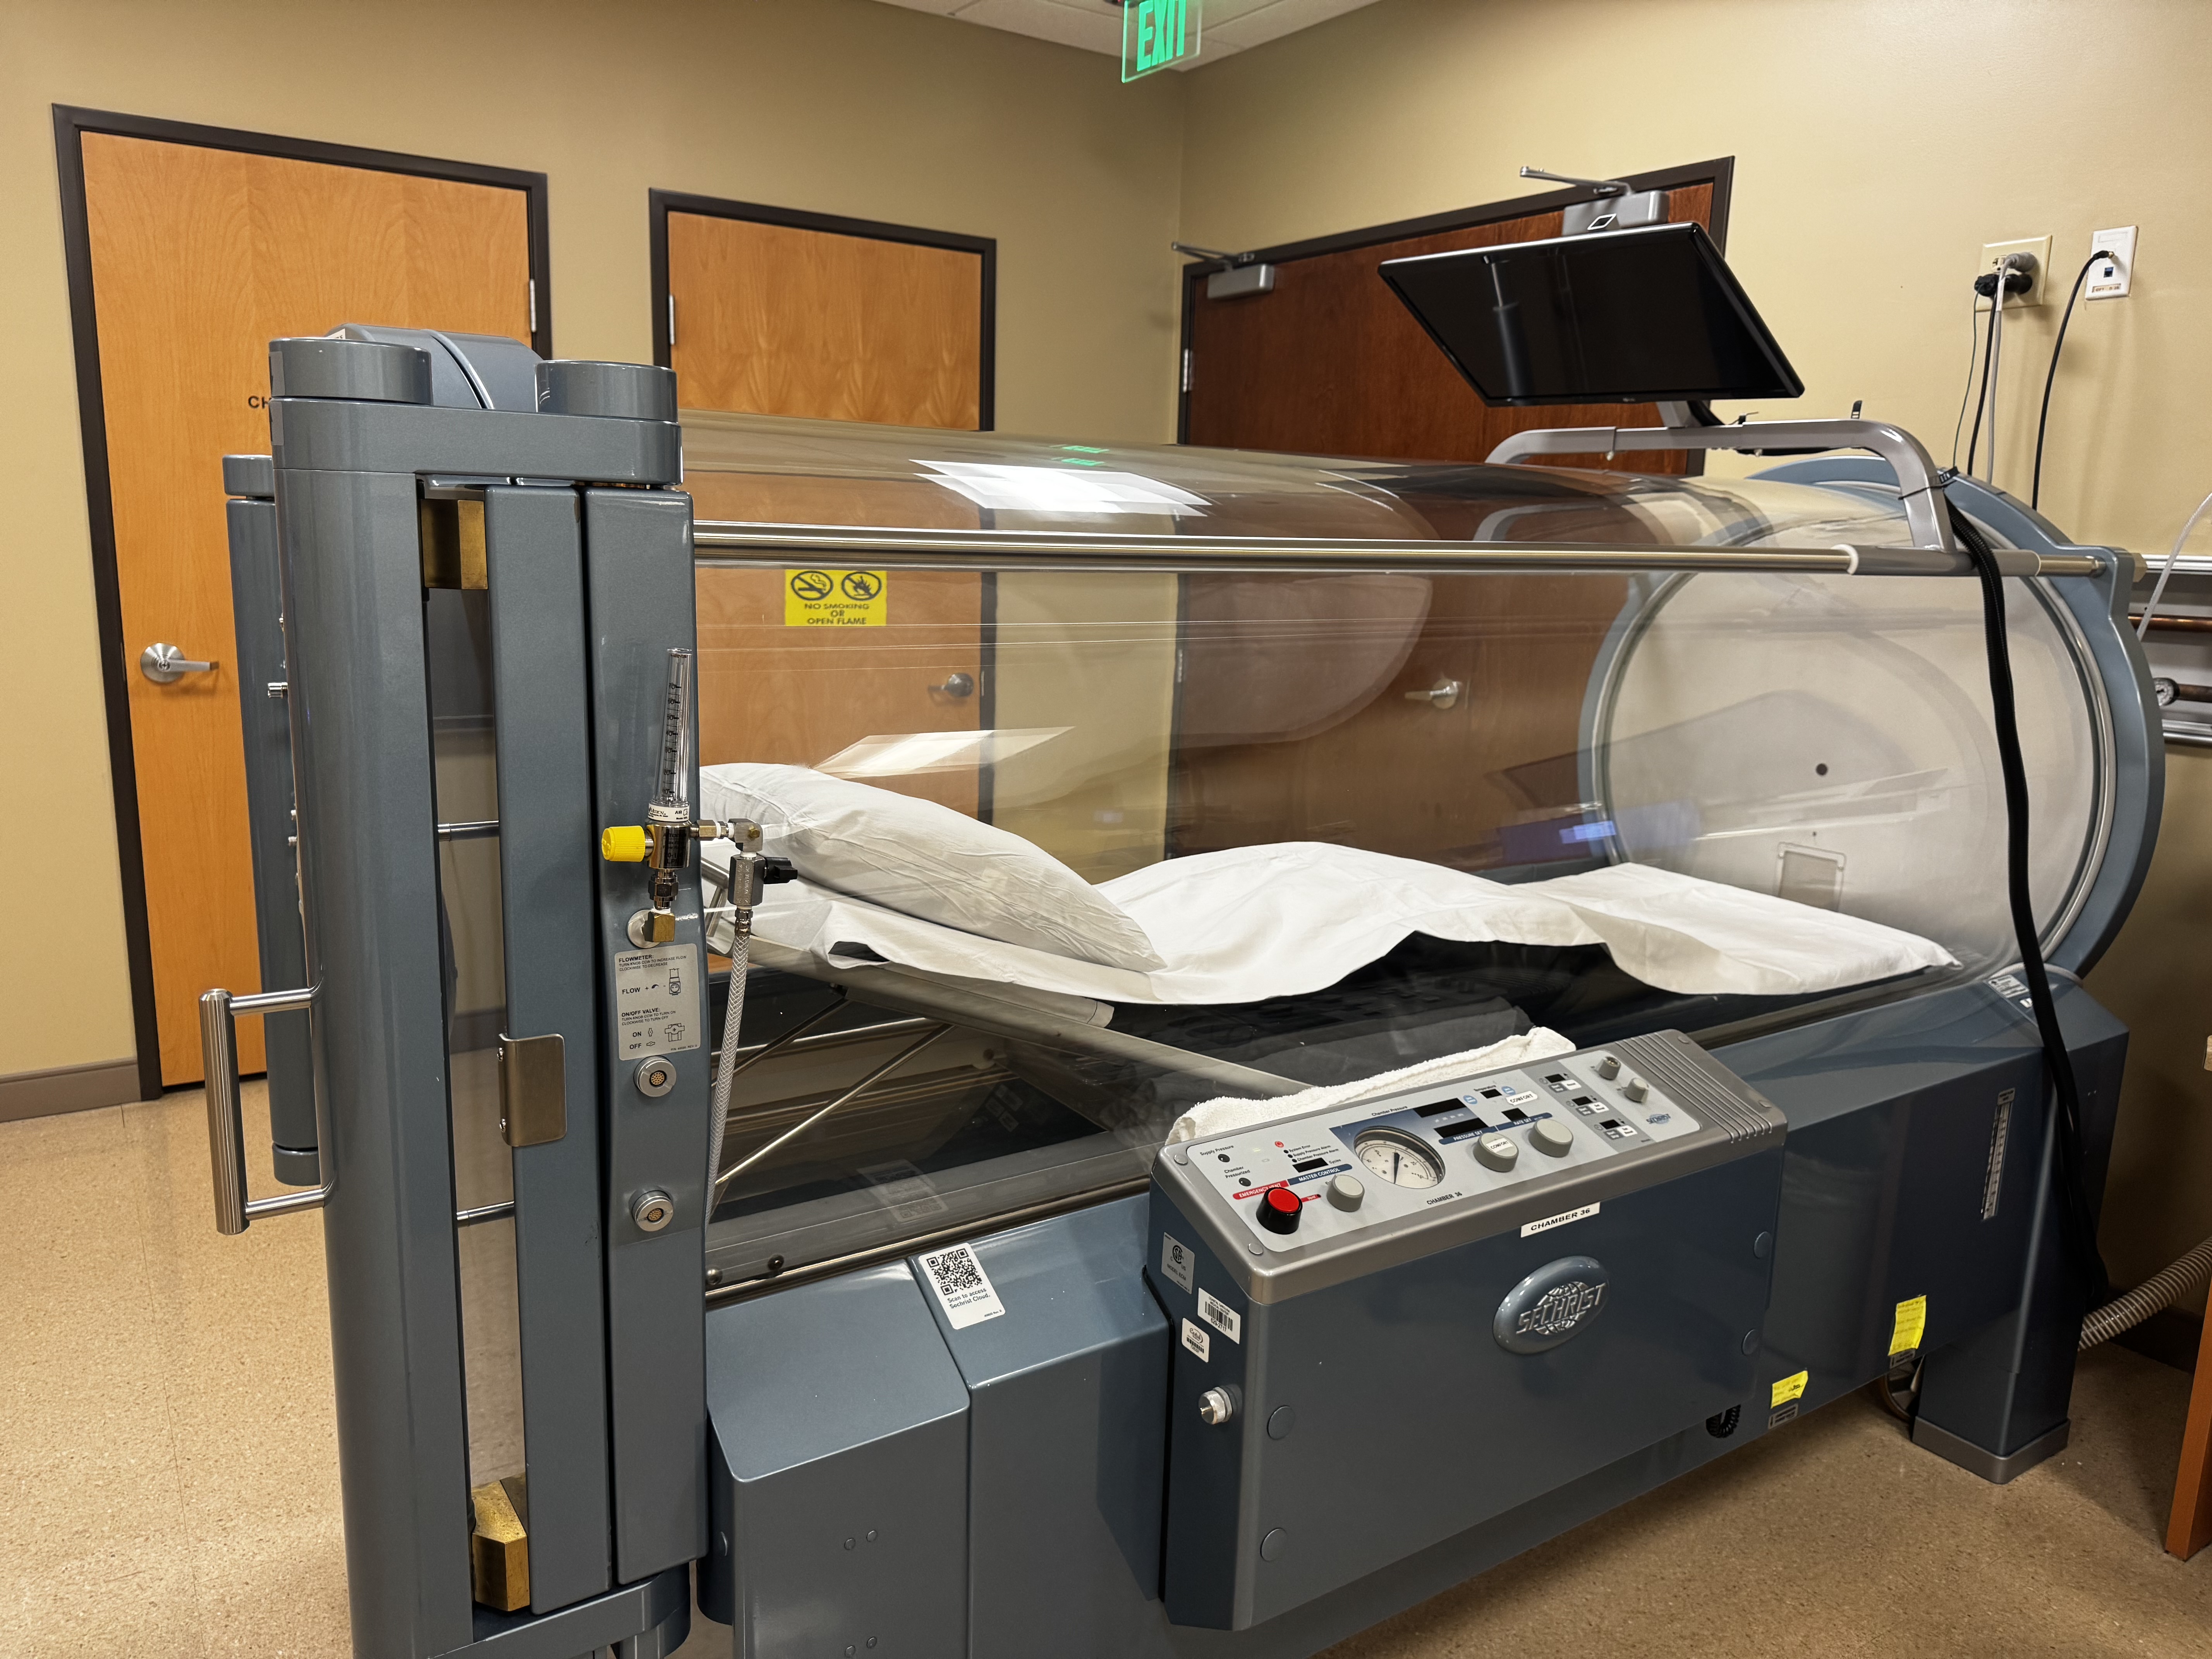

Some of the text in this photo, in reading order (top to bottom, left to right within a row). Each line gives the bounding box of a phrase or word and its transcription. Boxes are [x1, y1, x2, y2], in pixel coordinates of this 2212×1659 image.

[1510, 1094, 1534, 1103] COMFORT
[1453, 1132, 1475, 1140] PRESSURE
[1225, 1170, 1250, 1178] Pressurized
[1317, 1168, 1340, 1176] CONTROL
[1239, 1187, 1268, 1197] EMERGENCY
[1427, 1194, 1454, 1204] CHAMBER
[1531, 1212, 1578, 1231] CHAMBER
[1167, 1263, 1178, 1275] MODEL
[969, 1288, 986, 1296] access
[950, 1293, 990, 1309] Sechrist Cloud.
[1516, 1282, 1606, 1334] SECHRIST
